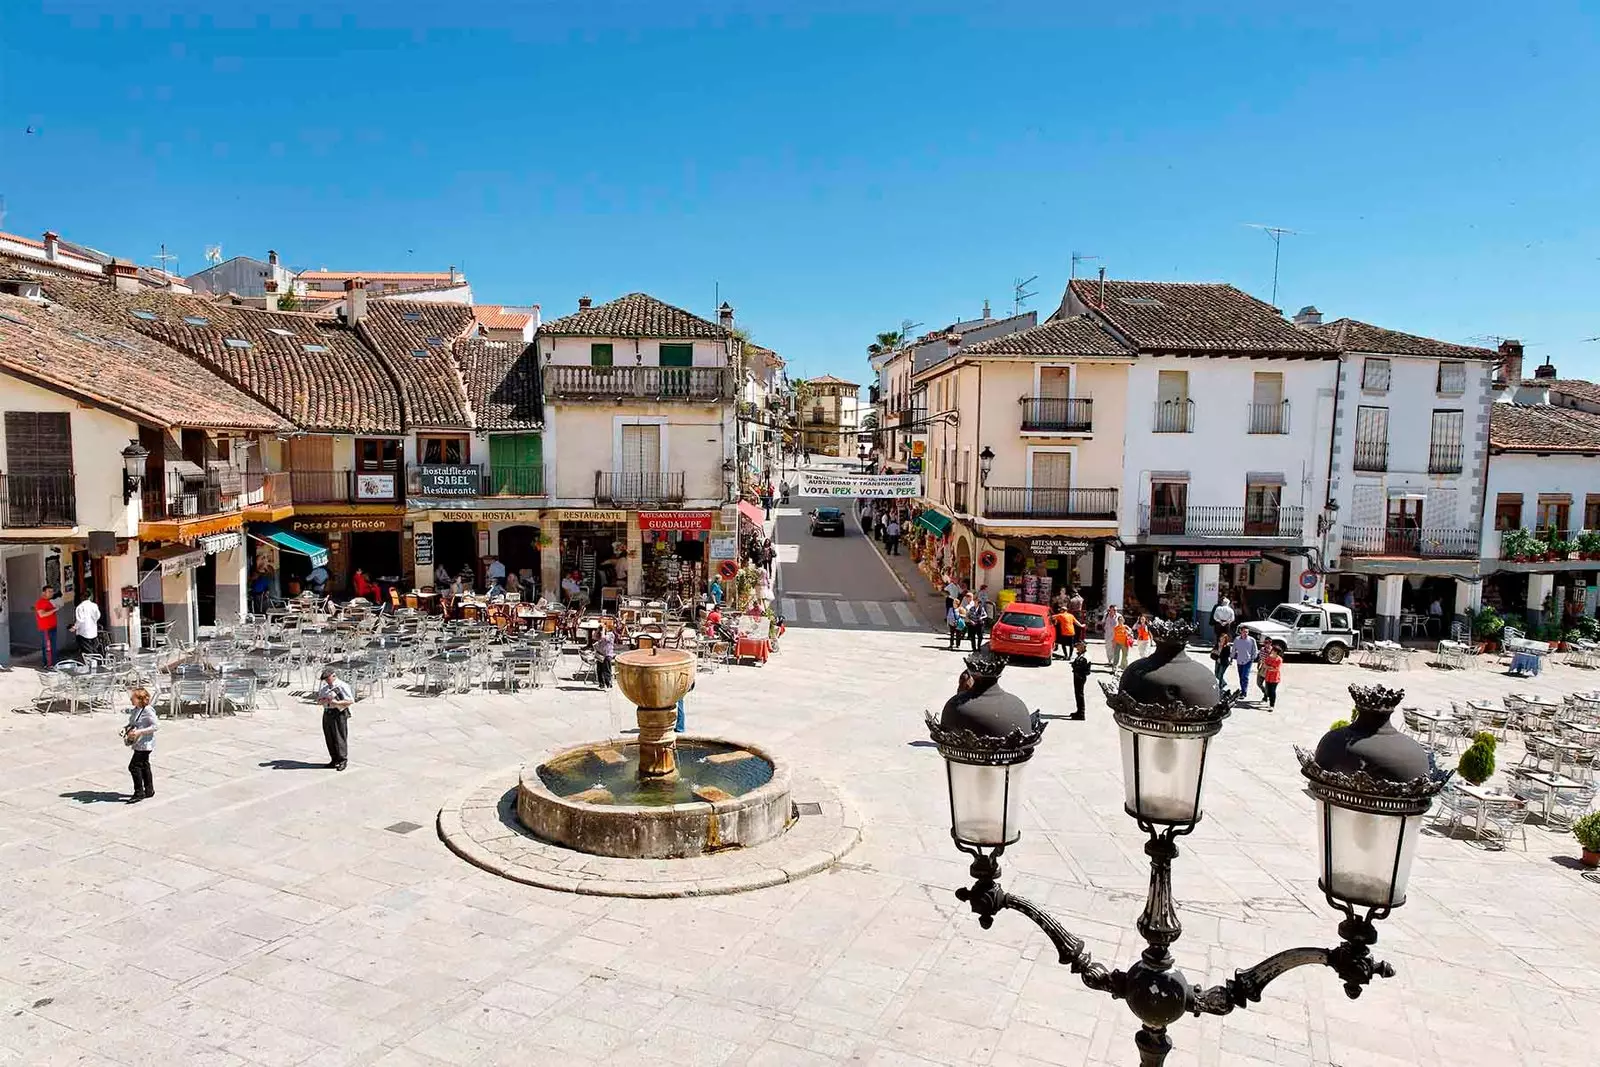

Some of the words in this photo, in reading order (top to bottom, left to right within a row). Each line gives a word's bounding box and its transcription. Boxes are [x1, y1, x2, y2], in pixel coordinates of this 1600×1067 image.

[433, 475, 470, 485] ISABEL
[423, 486, 477, 495] Restaurante
[804, 487, 830, 495] VOTA
[832, 486, 851, 495] IPEX
[860, 488, 885, 496] VOTA
[886, 488, 894, 496] A
[896, 487, 916, 496] PEPE
[443, 511, 473, 520] MESON
[482, 511, 517, 520] HOSTAL
[563, 511, 621, 520] RESTAURANTE
[293, 520, 338, 531] Posada
[351, 519, 386, 529] Rincón
[648, 520, 702, 528] GUADALUPE
